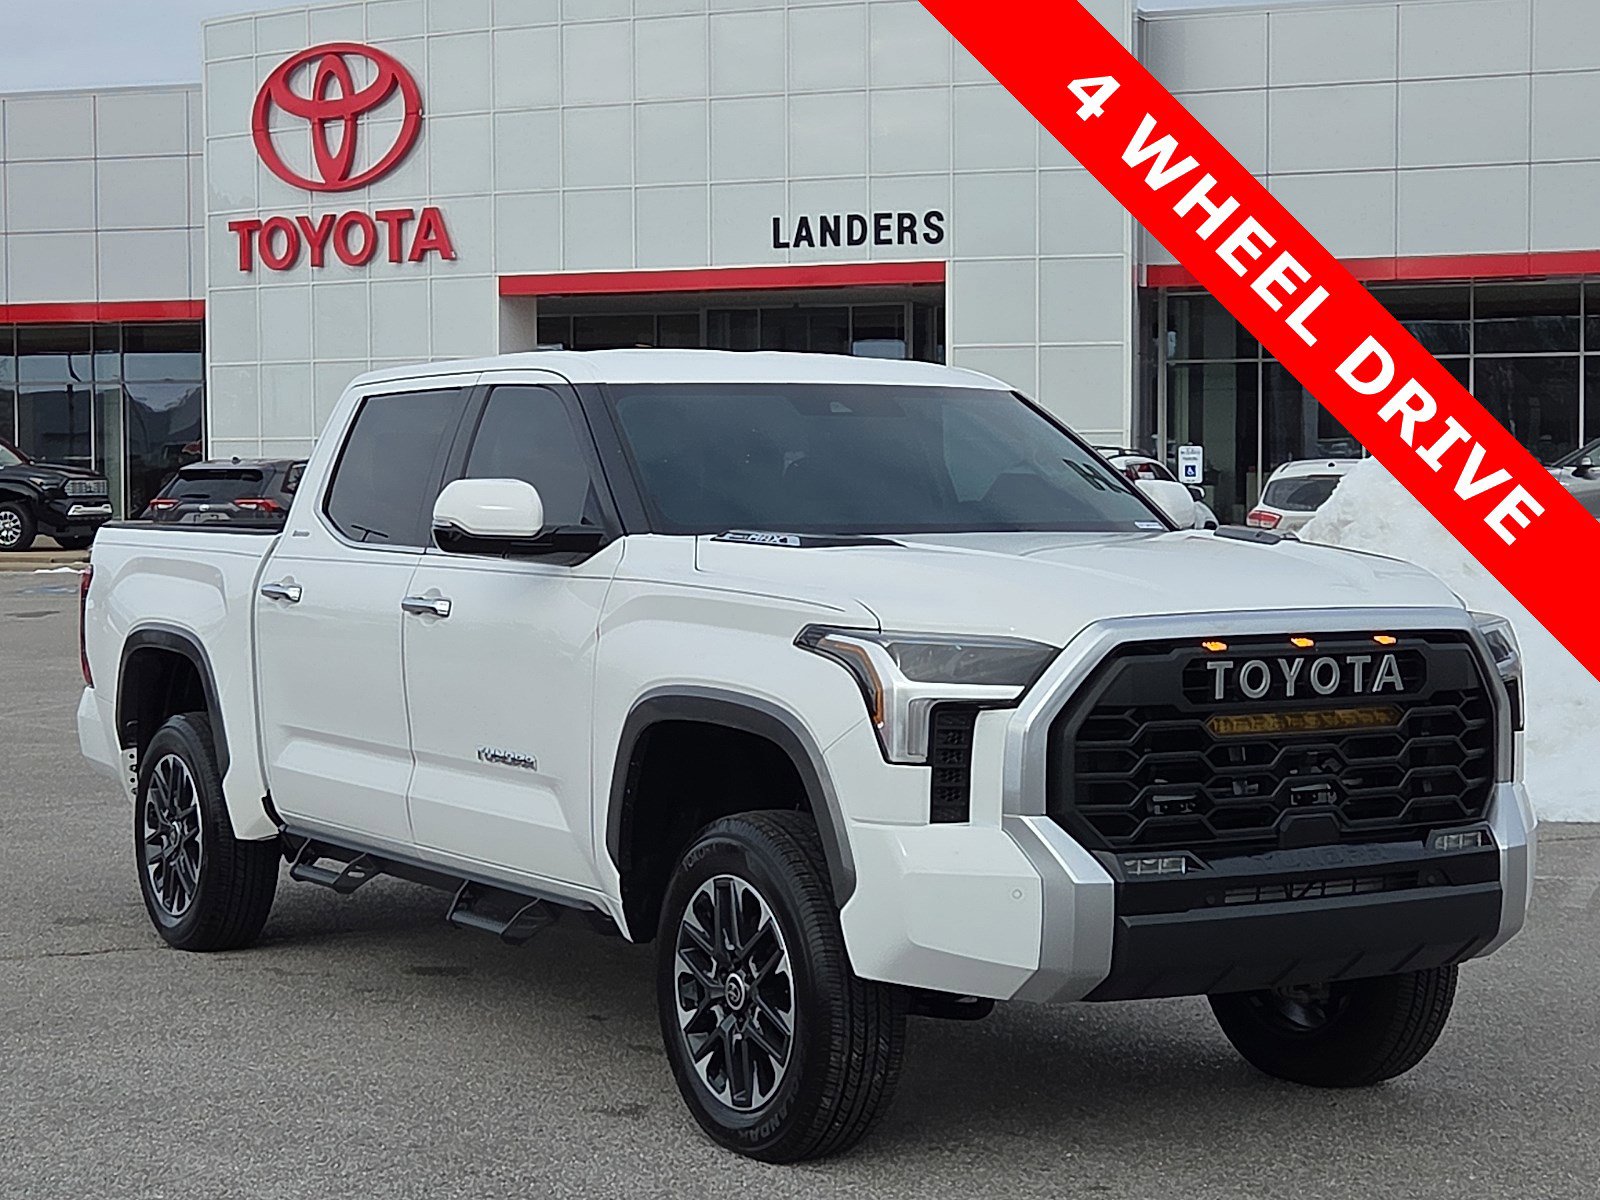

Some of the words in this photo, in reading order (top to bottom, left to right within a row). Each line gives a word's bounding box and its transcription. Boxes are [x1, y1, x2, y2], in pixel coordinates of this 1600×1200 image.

[228, 207, 457, 272] TOYOTA
[772, 210, 945, 248] LANDERS
[1206, 653, 1405, 700] TOYOTA
